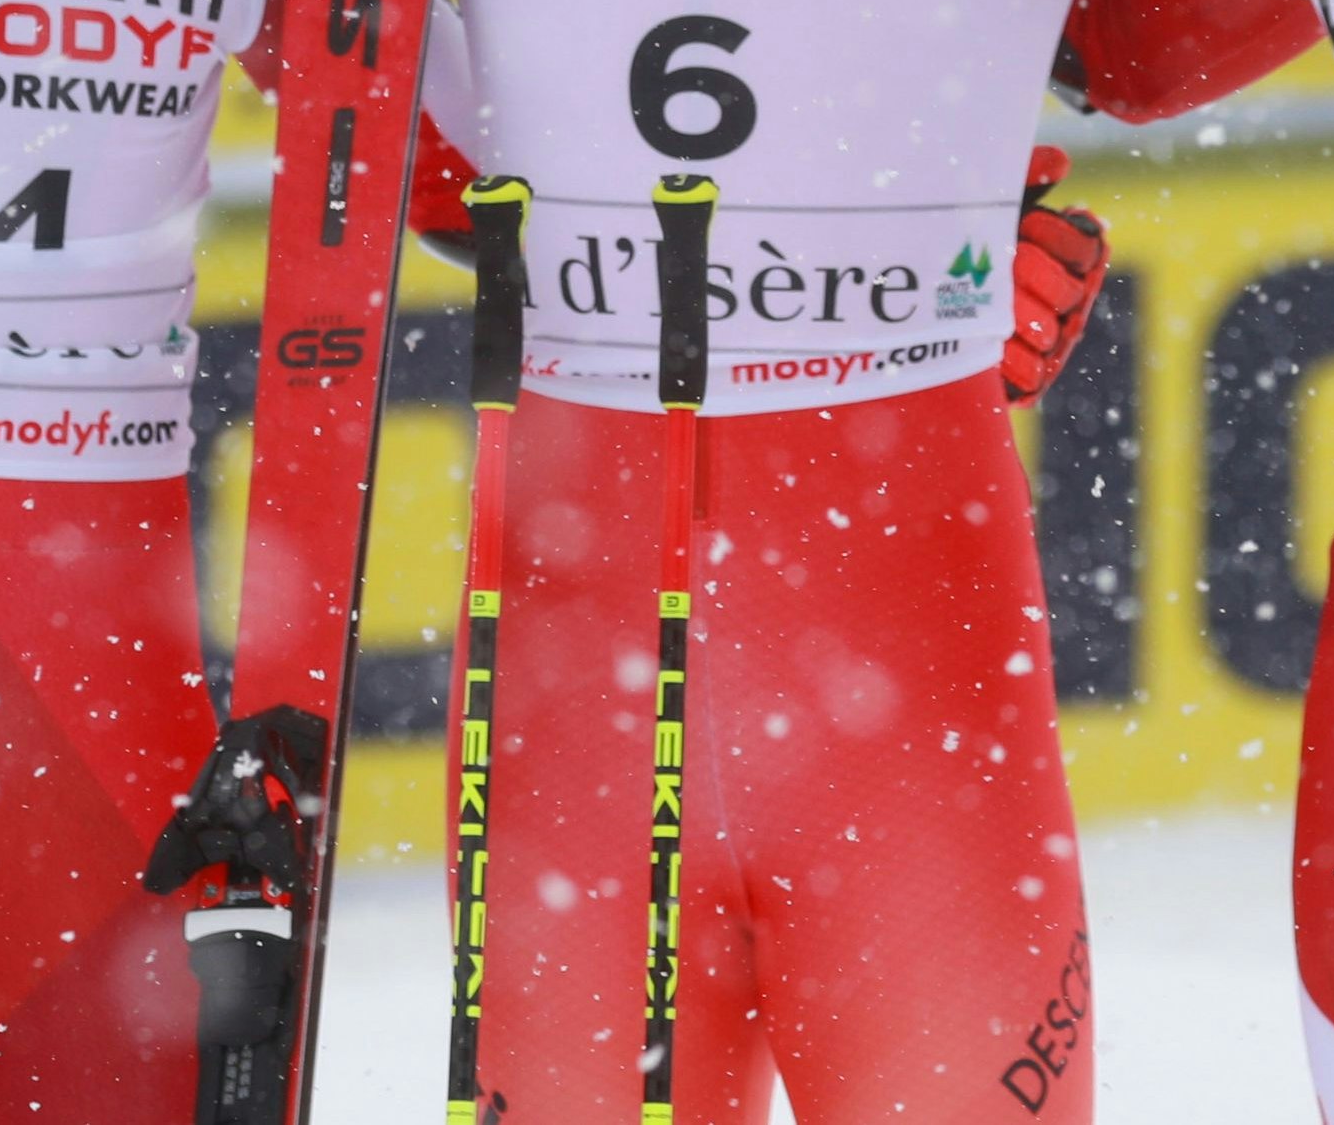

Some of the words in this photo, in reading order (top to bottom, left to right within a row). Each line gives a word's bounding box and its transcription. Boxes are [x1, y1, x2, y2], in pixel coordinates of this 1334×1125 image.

[628, 14, 758, 161] 6
[277, 327, 366, 369] GS
[458, 668, 492, 837] LEKI
[651, 669, 686, 839] LEKI
